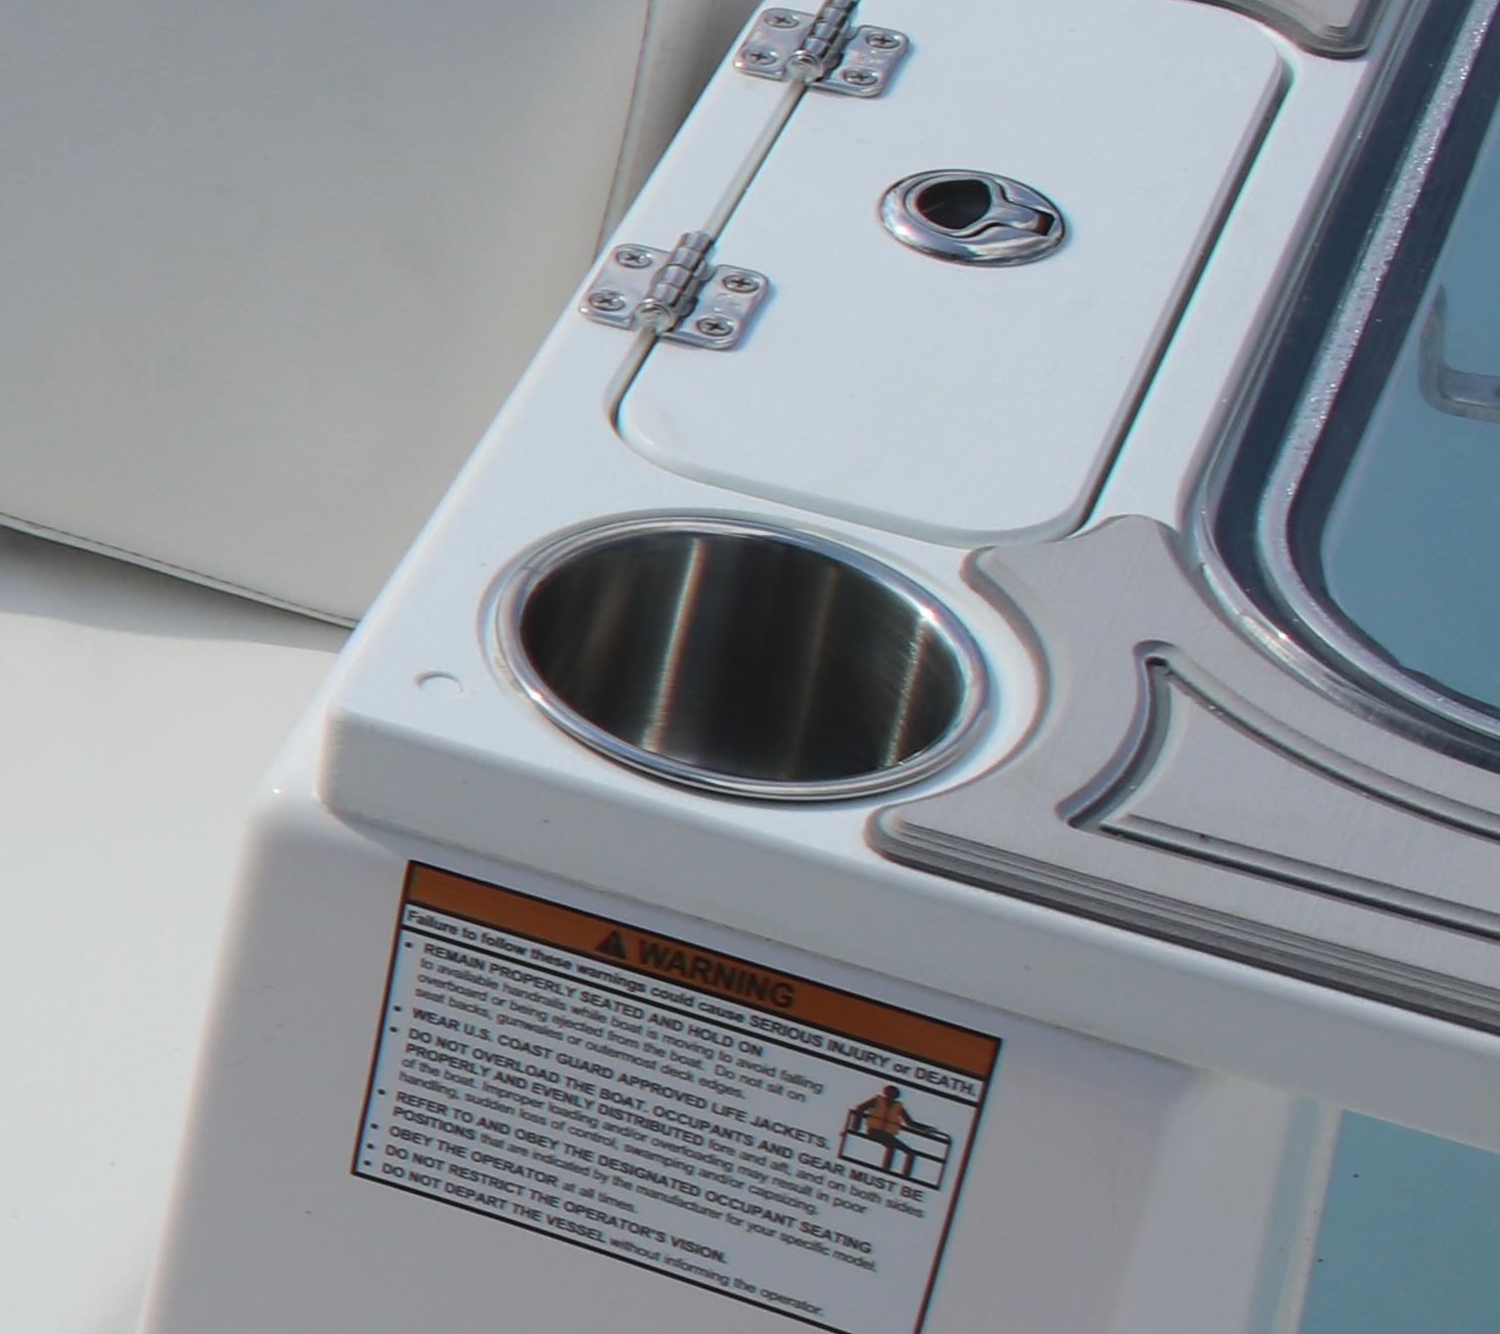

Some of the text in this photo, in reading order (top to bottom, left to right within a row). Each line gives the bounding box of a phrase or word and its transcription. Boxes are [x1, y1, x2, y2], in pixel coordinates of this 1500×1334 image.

[406, 908, 978, 1097] Failure to follow these warnings could cause SERIOUS INJURY or DEATH.
[424, 942, 762, 1057] REMAIN PROPERLY SEATED AND HOLD ON
[636, 938, 796, 1010] WARNING
[405, 1041, 490, 1079] PROPERLY
[493, 1069, 526, 1091] AND
[531, 1082, 593, 1112] EVENLY
[597, 1103, 703, 1148] DISTRIBUTED
[708, 1138, 735, 1158] fore
[739, 1148, 765, 1168] and
[795, 1166, 823, 1186] and
[827, 1179, 844, 1193] on
[849, 1184, 881, 1205] both
[885, 1195, 924, 1218] sides
[407, 1026, 924, 1202] DO NOT OVERLOAD THE BOAT. OCCUPANTS AND GEAR MUST BE
[412, 1006, 831, 1150] WEAR U.S. COAST GUARD APPROVED LIFE JACKETS.
[382, 1160, 404, 1179] DO
[408, 1169, 440, 1191] NOT
[444, 1180, 506, 1212] DEPART
[510, 1202, 542, 1224] THE
[544, 1214, 606, 1245] VESSEL
[609, 1235, 659, 1263] without
[662, 1253, 729, 1288] informing
[733, 1276, 756, 1295] the
[385, 1142, 727, 1264] DO NOT RESTRICT THE OPERATOR'S VISION.
[388, 1123, 432, 1148] OBEY
[436, 1138, 467, 1159] THE
[470, 1149, 558, 1188] OPERATOR
[562, 1179, 576, 1194] at
[578, 1184, 594, 1200] all
[395, 1088, 872, 1254] REFER TO AND OBEY THE DESIGNATED OCCUPANT SEATING
